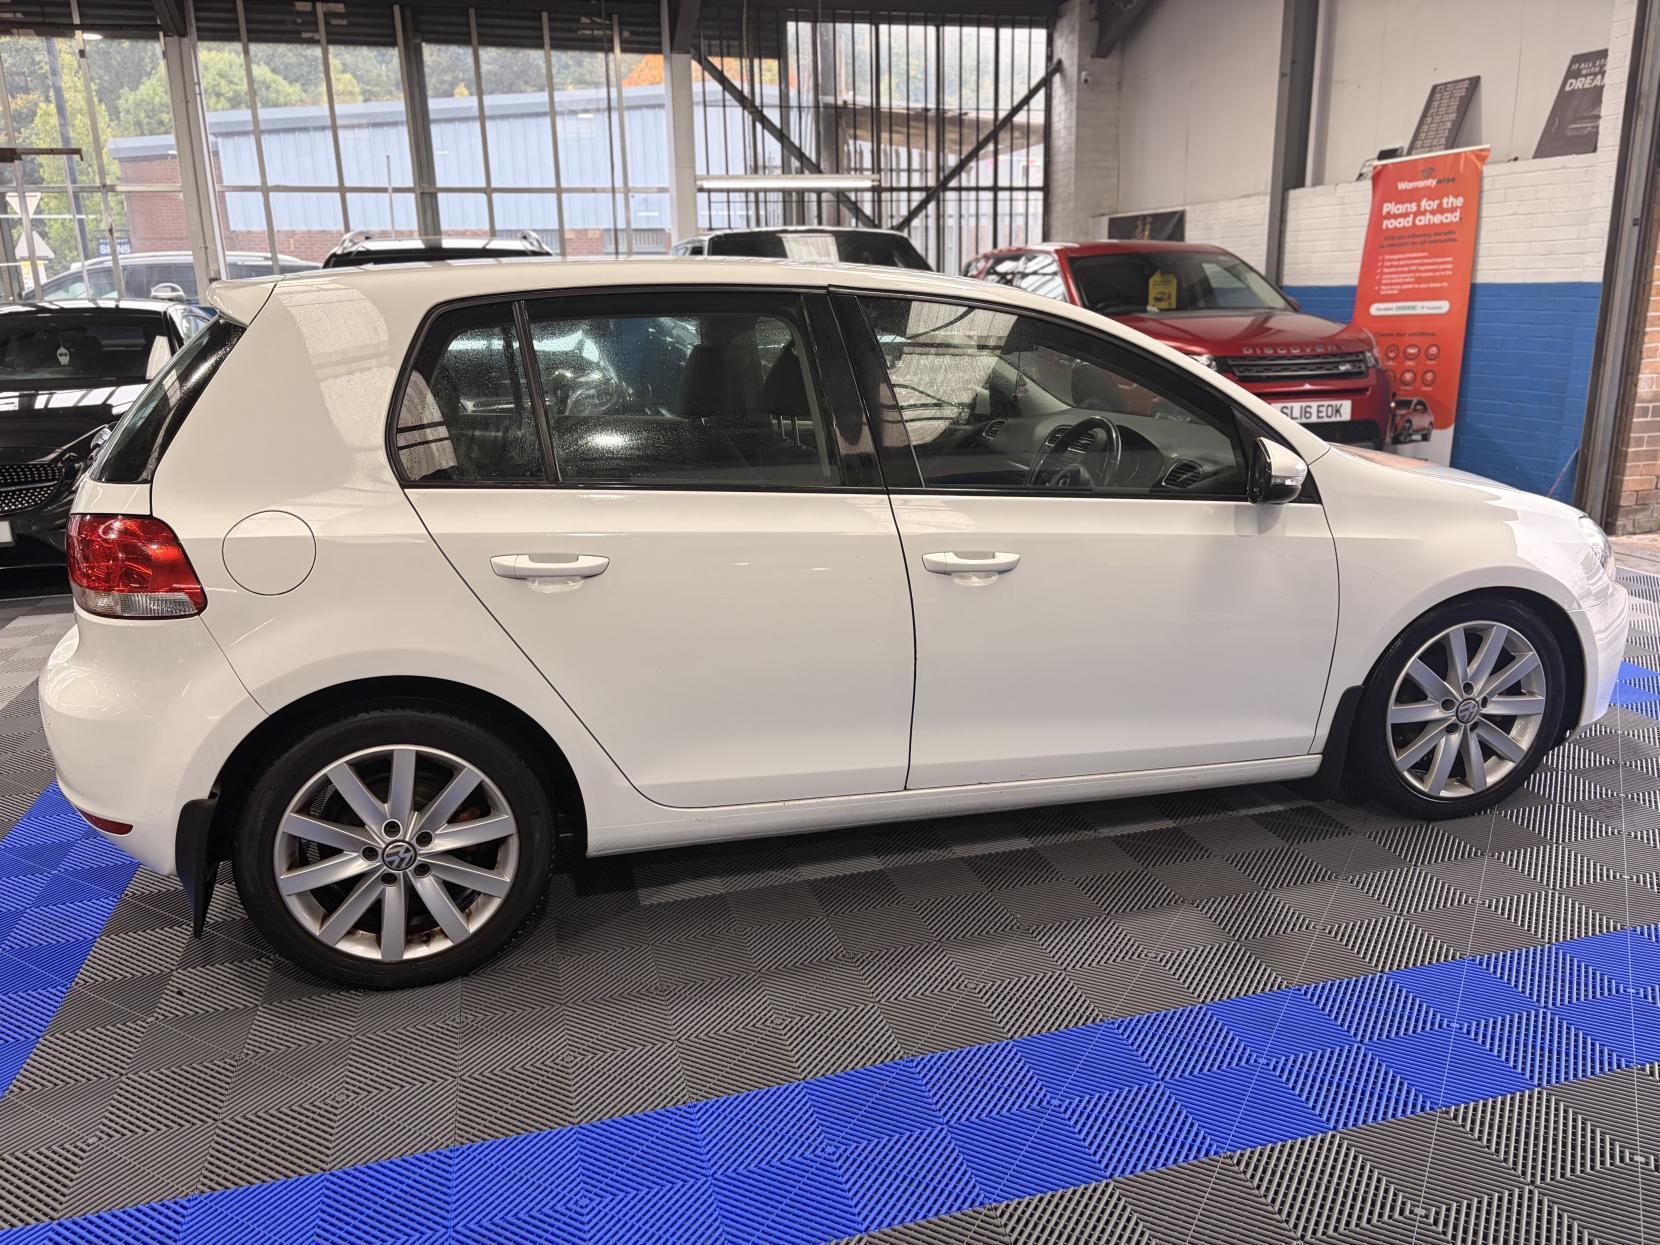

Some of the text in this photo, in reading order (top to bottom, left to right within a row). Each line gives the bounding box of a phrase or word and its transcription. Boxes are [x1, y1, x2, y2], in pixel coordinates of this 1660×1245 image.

[1579, 61, 1592, 69] ALL
[1382, 195, 1464, 216] Plans for the
[1382, 214, 1413, 229] road
[99, 243, 131, 254] SINS
[1281, 403, 1343, 421] SL16 EOK
